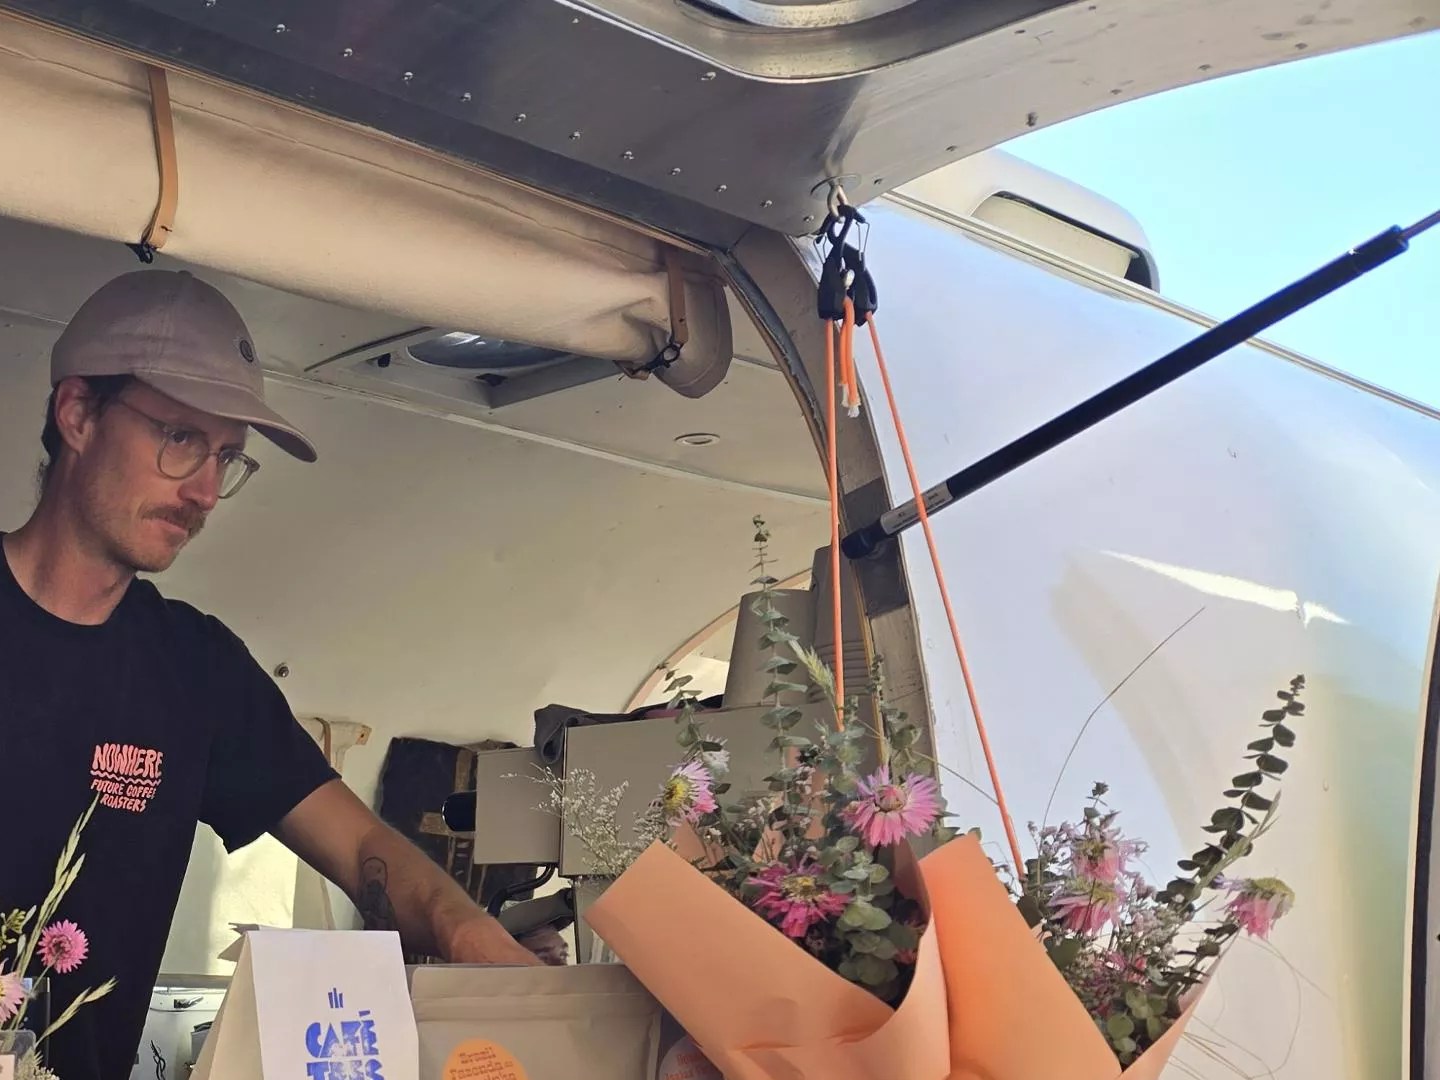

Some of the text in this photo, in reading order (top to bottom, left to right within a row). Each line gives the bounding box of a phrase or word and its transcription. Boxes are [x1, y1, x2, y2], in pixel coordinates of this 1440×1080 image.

[91, 742, 163, 778] NOWHERE
[90, 779, 125, 795] FUTURE
[100, 793, 147, 813] ROASTERS
[305, 1010, 379, 1058] CAFÉ
